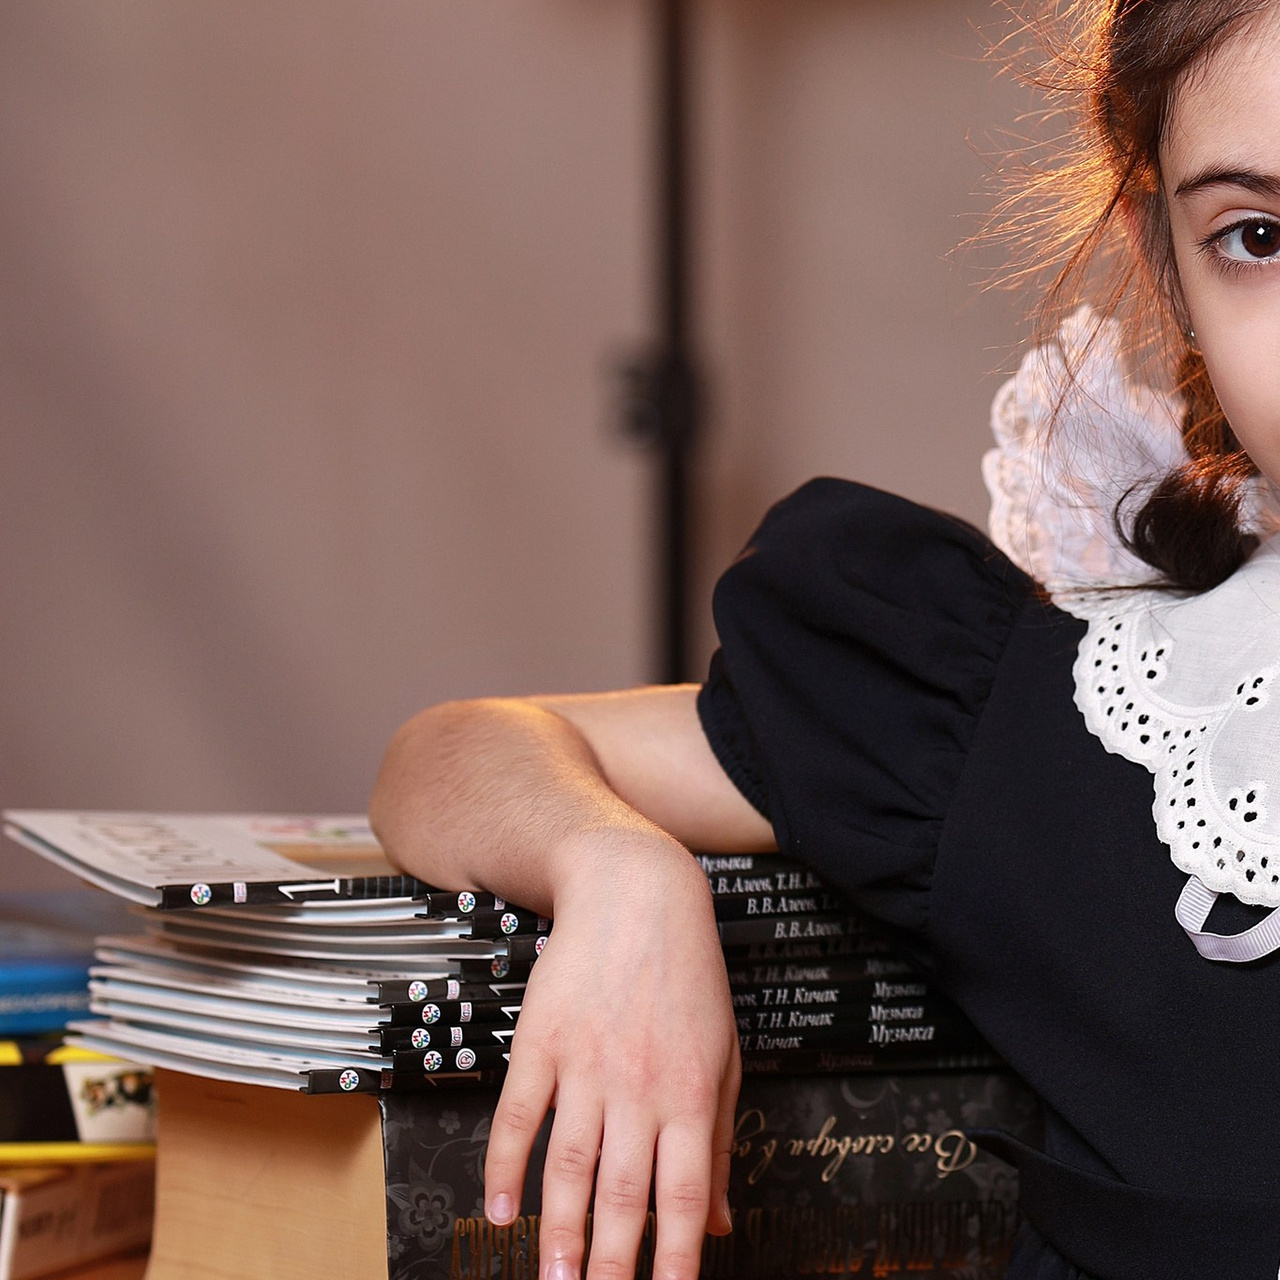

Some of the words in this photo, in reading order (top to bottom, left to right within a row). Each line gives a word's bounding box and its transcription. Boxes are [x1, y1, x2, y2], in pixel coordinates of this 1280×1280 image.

[277, 878, 340, 900] 1
[793, 985, 840, 1005] Кичак
[872, 980, 928, 1002] Музыка
[787, 1009, 835, 1028] Кичак
[868, 1004, 925, 1024] Музыка
[755, 1034, 803, 1052] Кичак
[867, 1023, 936, 1048] Музыка
[784, 1115, 895, 1184] словари
[901, 1128, 977, 1180] Все
